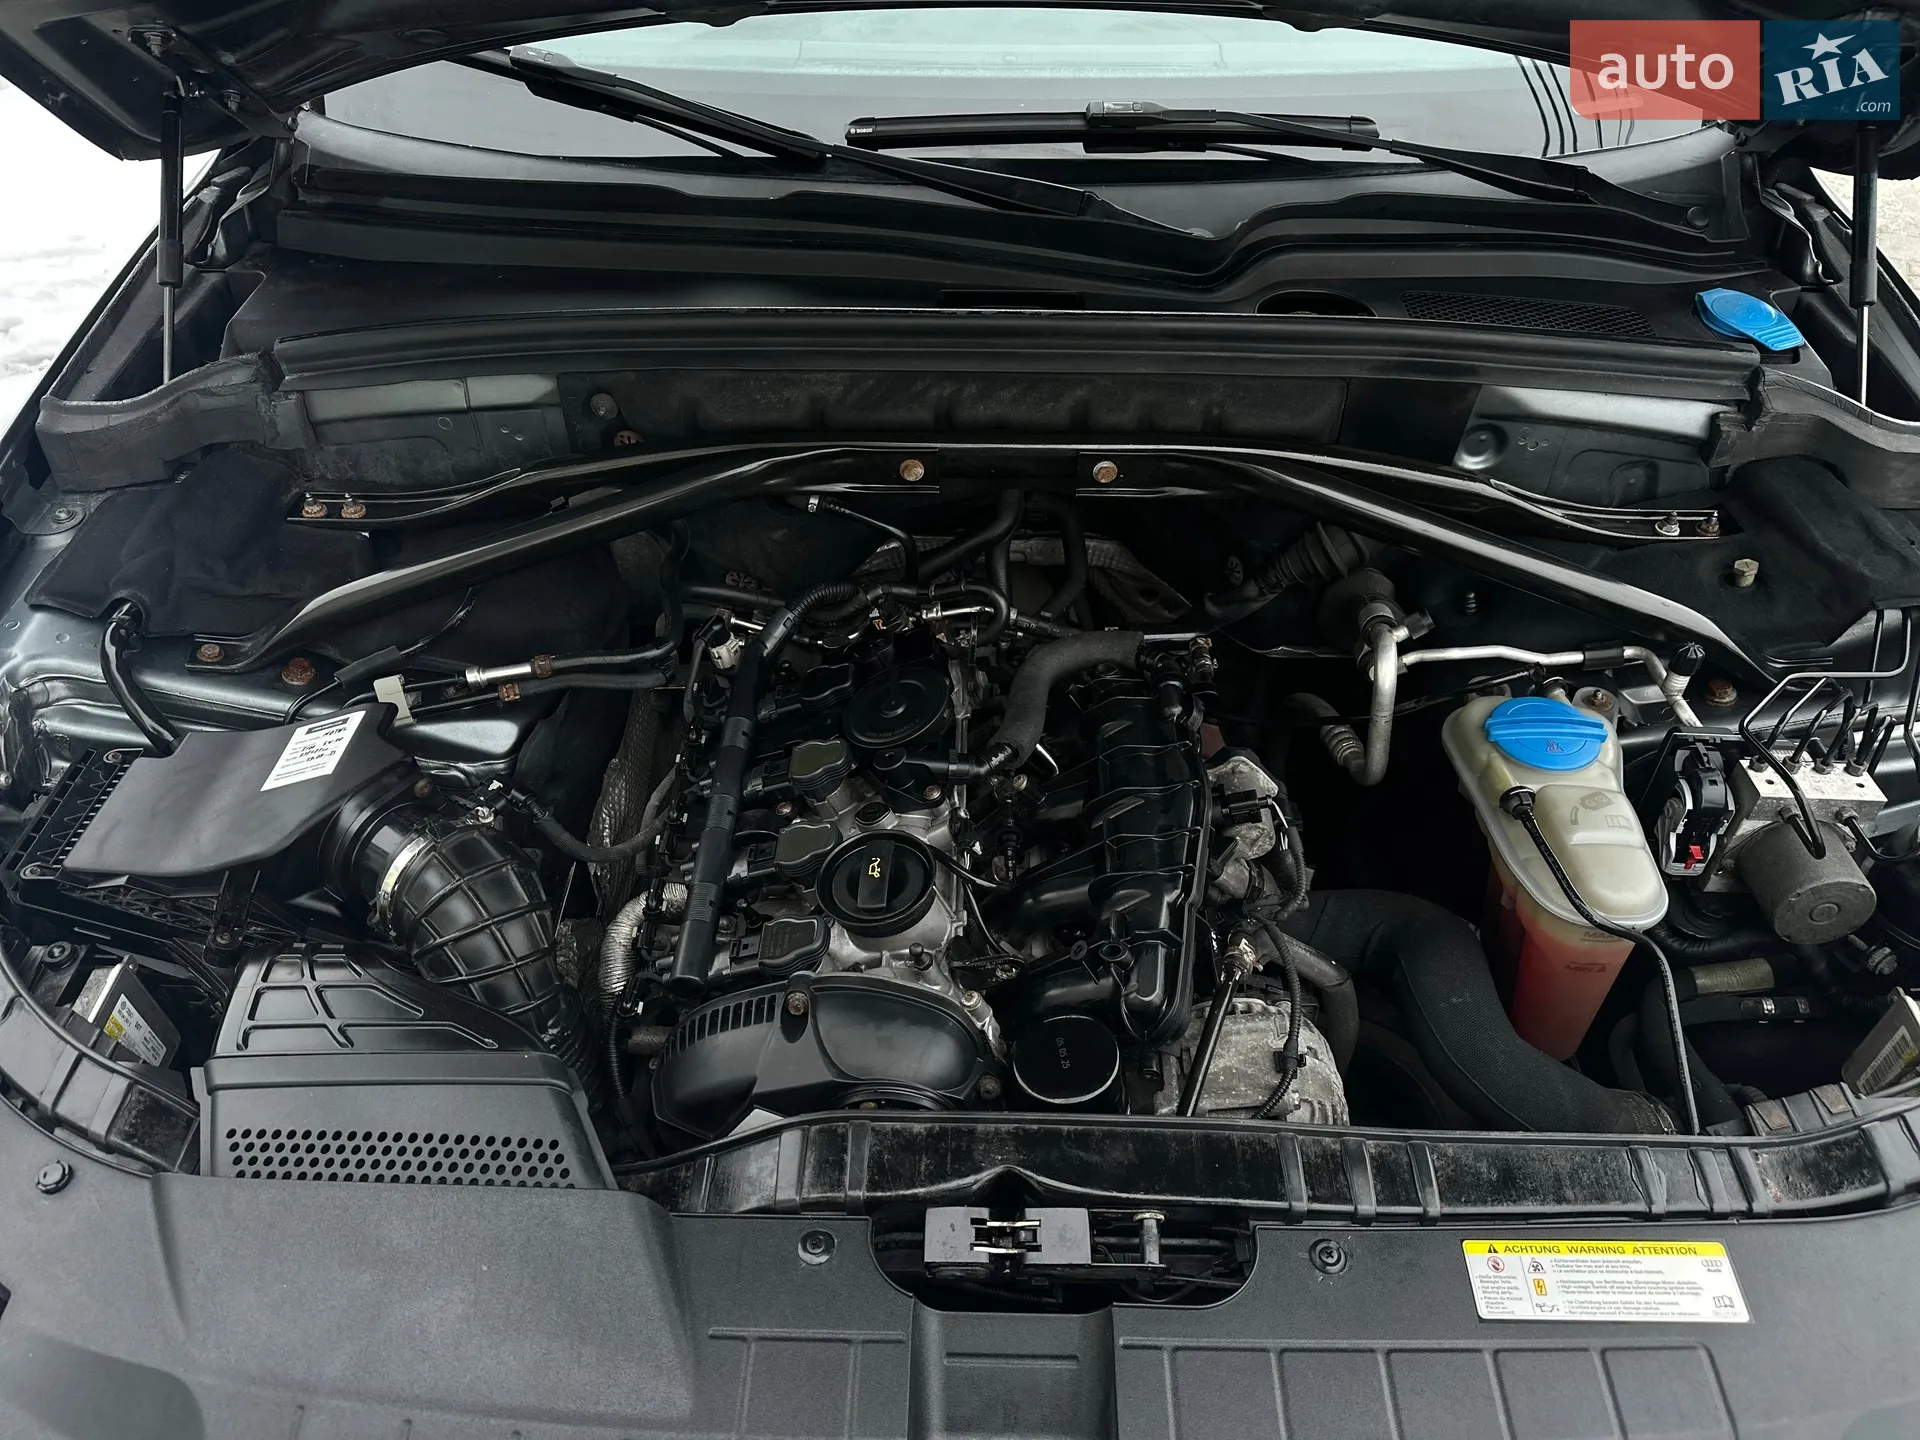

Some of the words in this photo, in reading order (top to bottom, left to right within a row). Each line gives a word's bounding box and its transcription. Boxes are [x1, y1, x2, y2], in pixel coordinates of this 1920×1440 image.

[1564, 964, 1594, 972] MIN
[1504, 1244, 1561, 1254] ACHTUNG
[1566, 1245, 1626, 1254] WARNING
[1632, 1246, 1698, 1255] ATTENTION
